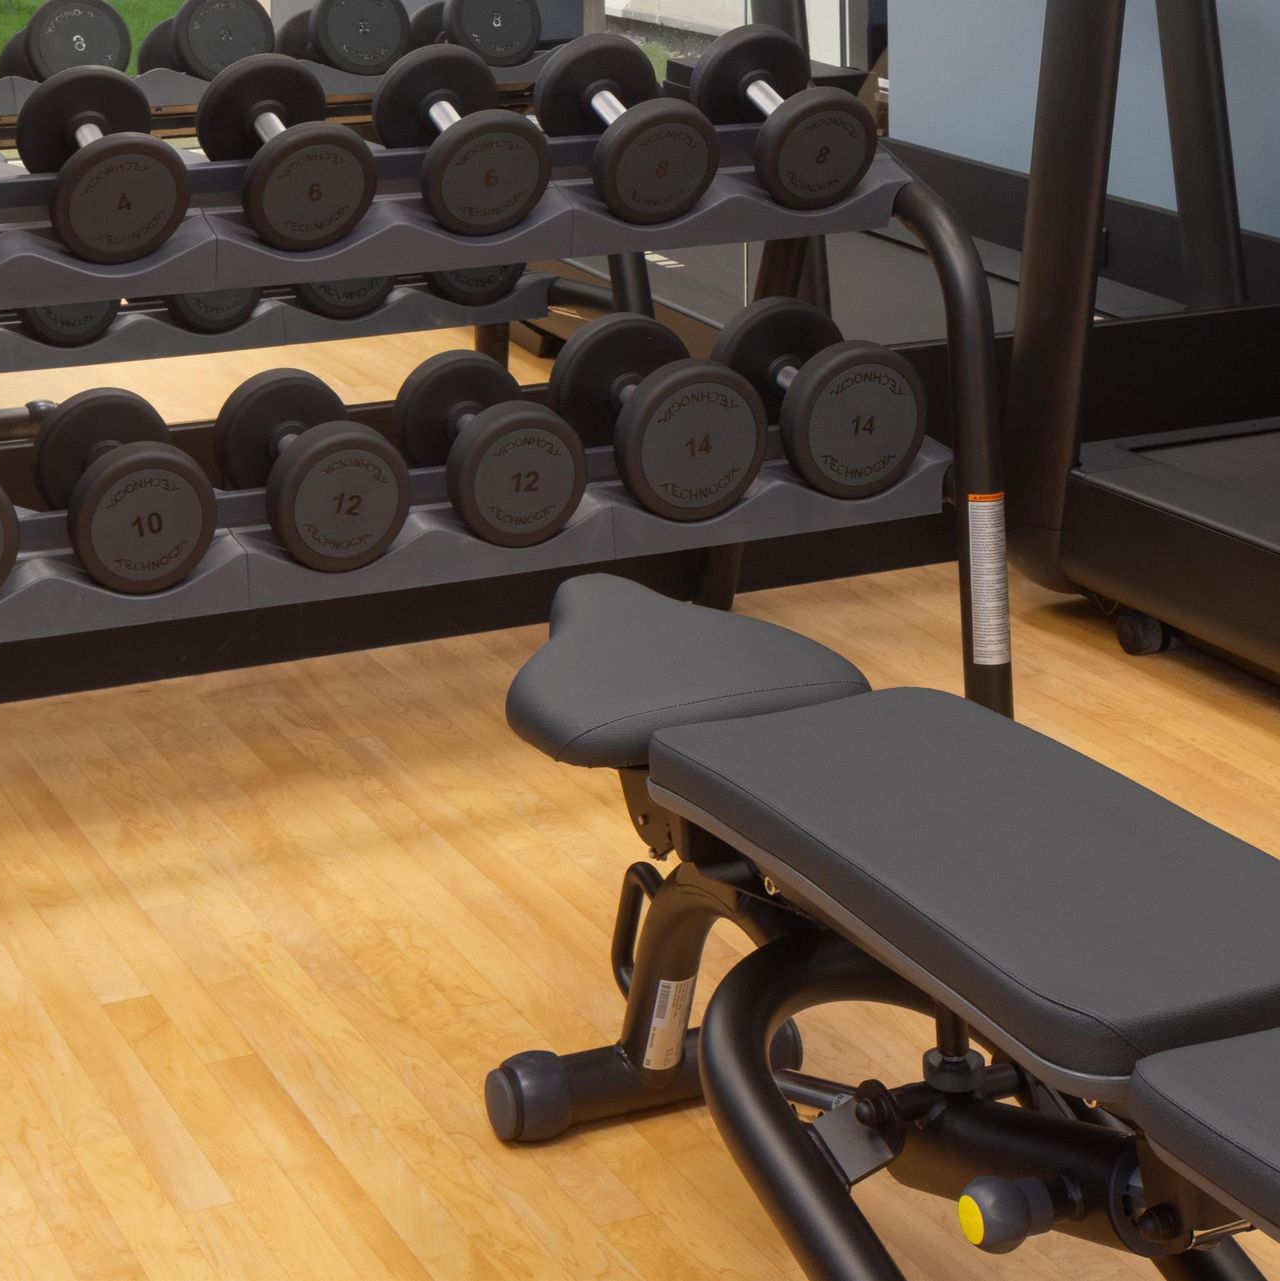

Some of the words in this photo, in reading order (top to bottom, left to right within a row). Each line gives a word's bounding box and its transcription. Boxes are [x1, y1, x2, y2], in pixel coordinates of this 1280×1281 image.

[851, 415, 875, 436] 14
[685, 434, 713, 457] 14
[511, 471, 539, 492] 12
[333, 493, 362, 516] 12
[132, 512, 163, 538] 10
